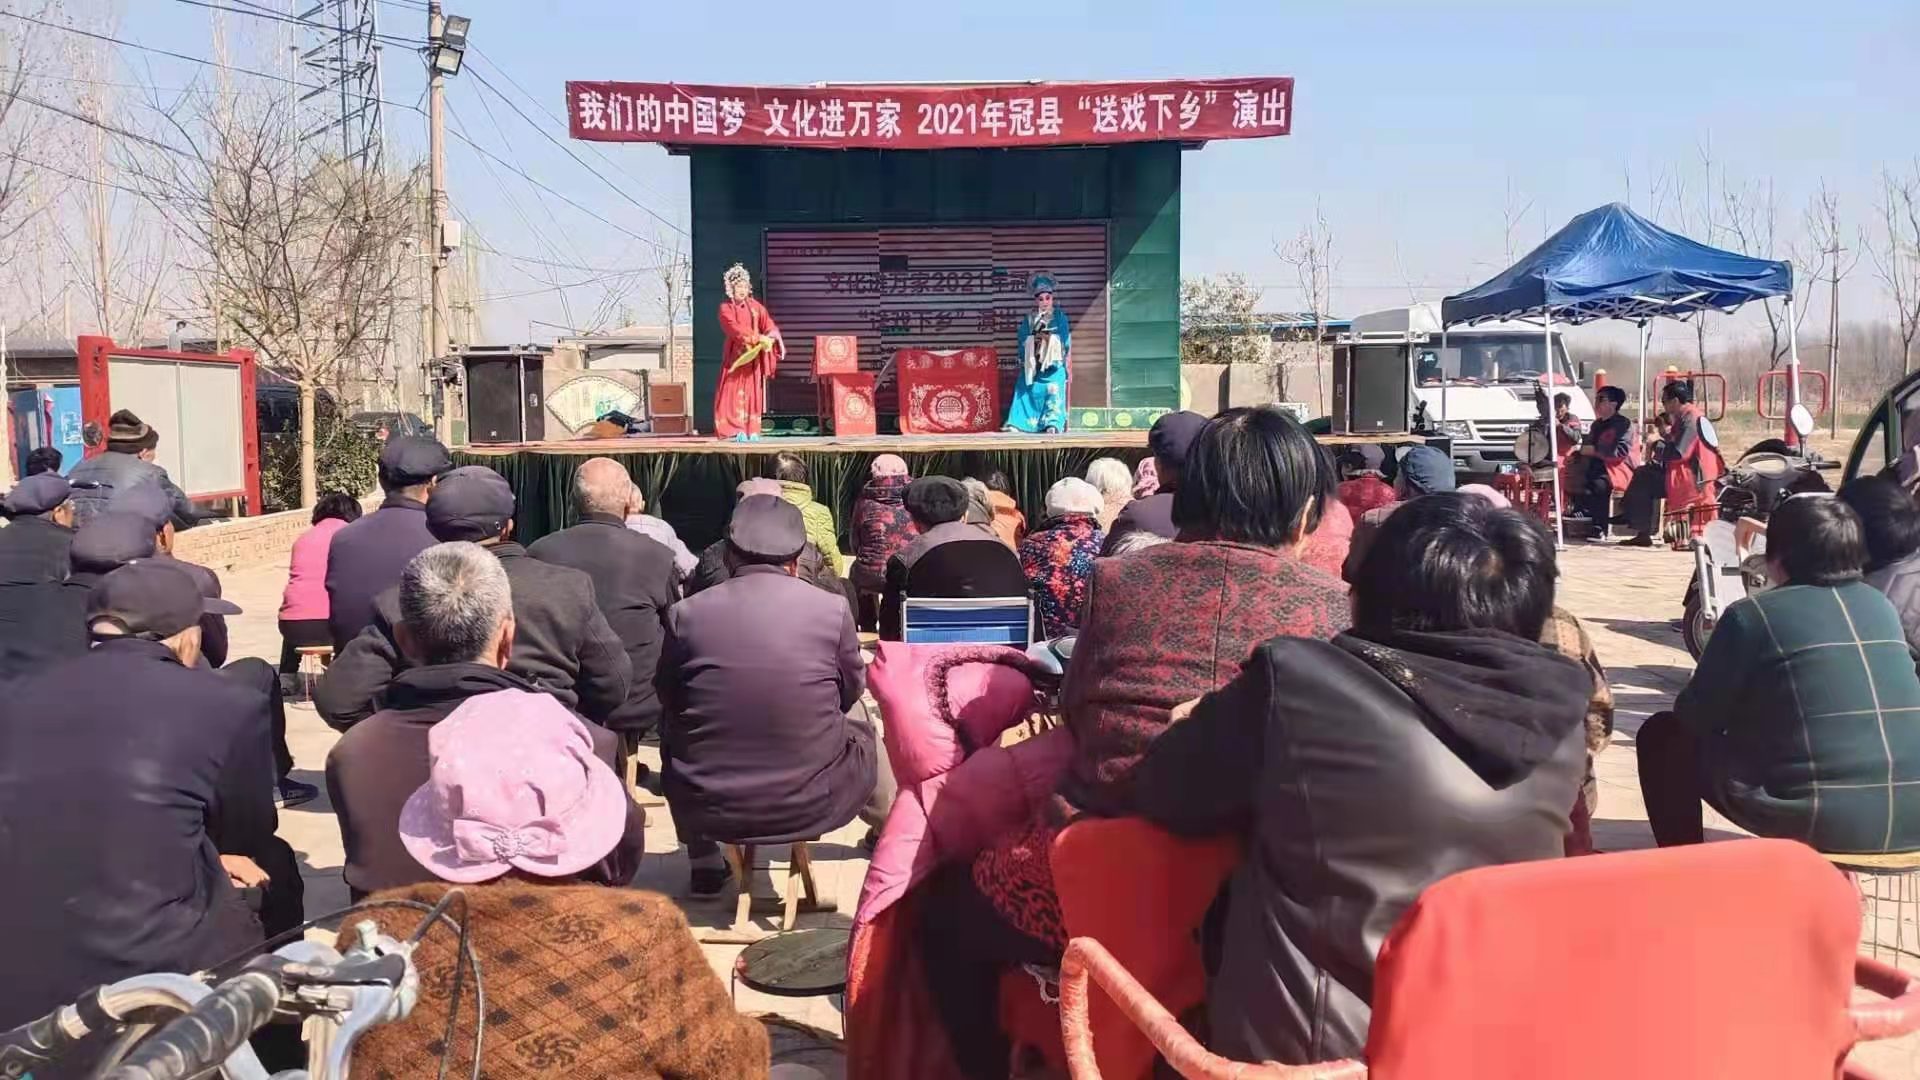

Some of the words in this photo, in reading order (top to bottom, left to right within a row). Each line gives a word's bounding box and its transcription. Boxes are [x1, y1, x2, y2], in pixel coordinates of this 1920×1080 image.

[579, 91, 746, 137] 我们的中国梦
[764, 98, 902, 138] 文化进万家
[917, 97, 1063, 136] 2021年冠县
[1077, 90, 1217, 133] “送戏下乡”
[1231, 88, 1286, 129] 演出
[824, 271, 1042, 293] 文化进万家2021年冠
